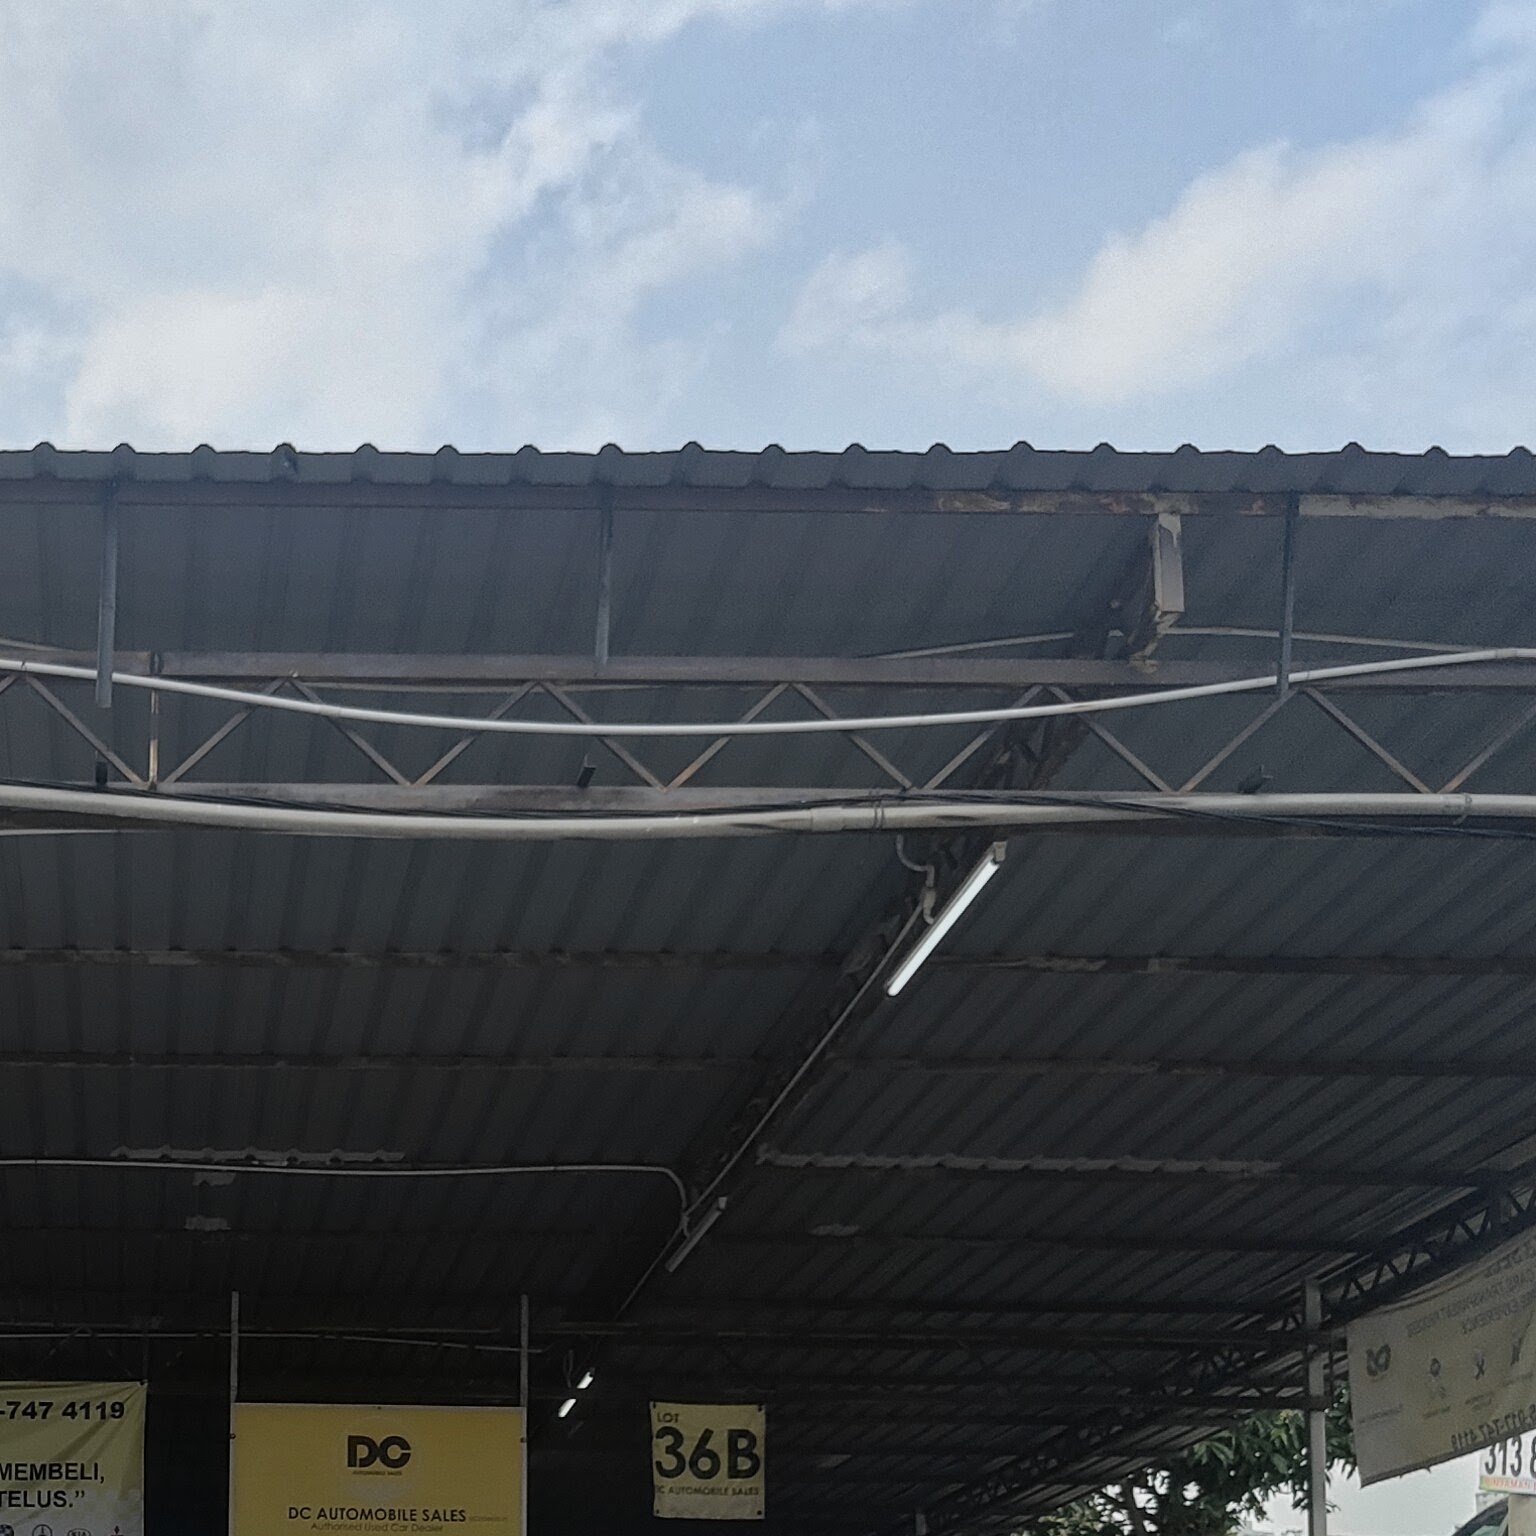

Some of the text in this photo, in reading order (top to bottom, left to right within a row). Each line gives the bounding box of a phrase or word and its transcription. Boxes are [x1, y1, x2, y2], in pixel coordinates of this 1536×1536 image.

[62, 1401, 125, 1420] 4119
[657, 1413, 679, 1423] LOT
[347, 1435, 411, 1469] DC
[655, 1426, 761, 1480] 36B
[288, 1506, 311, 1519] DC
[317, 1507, 417, 1521] AUTOMOBILE
[422, 1509, 466, 1522] SALES
